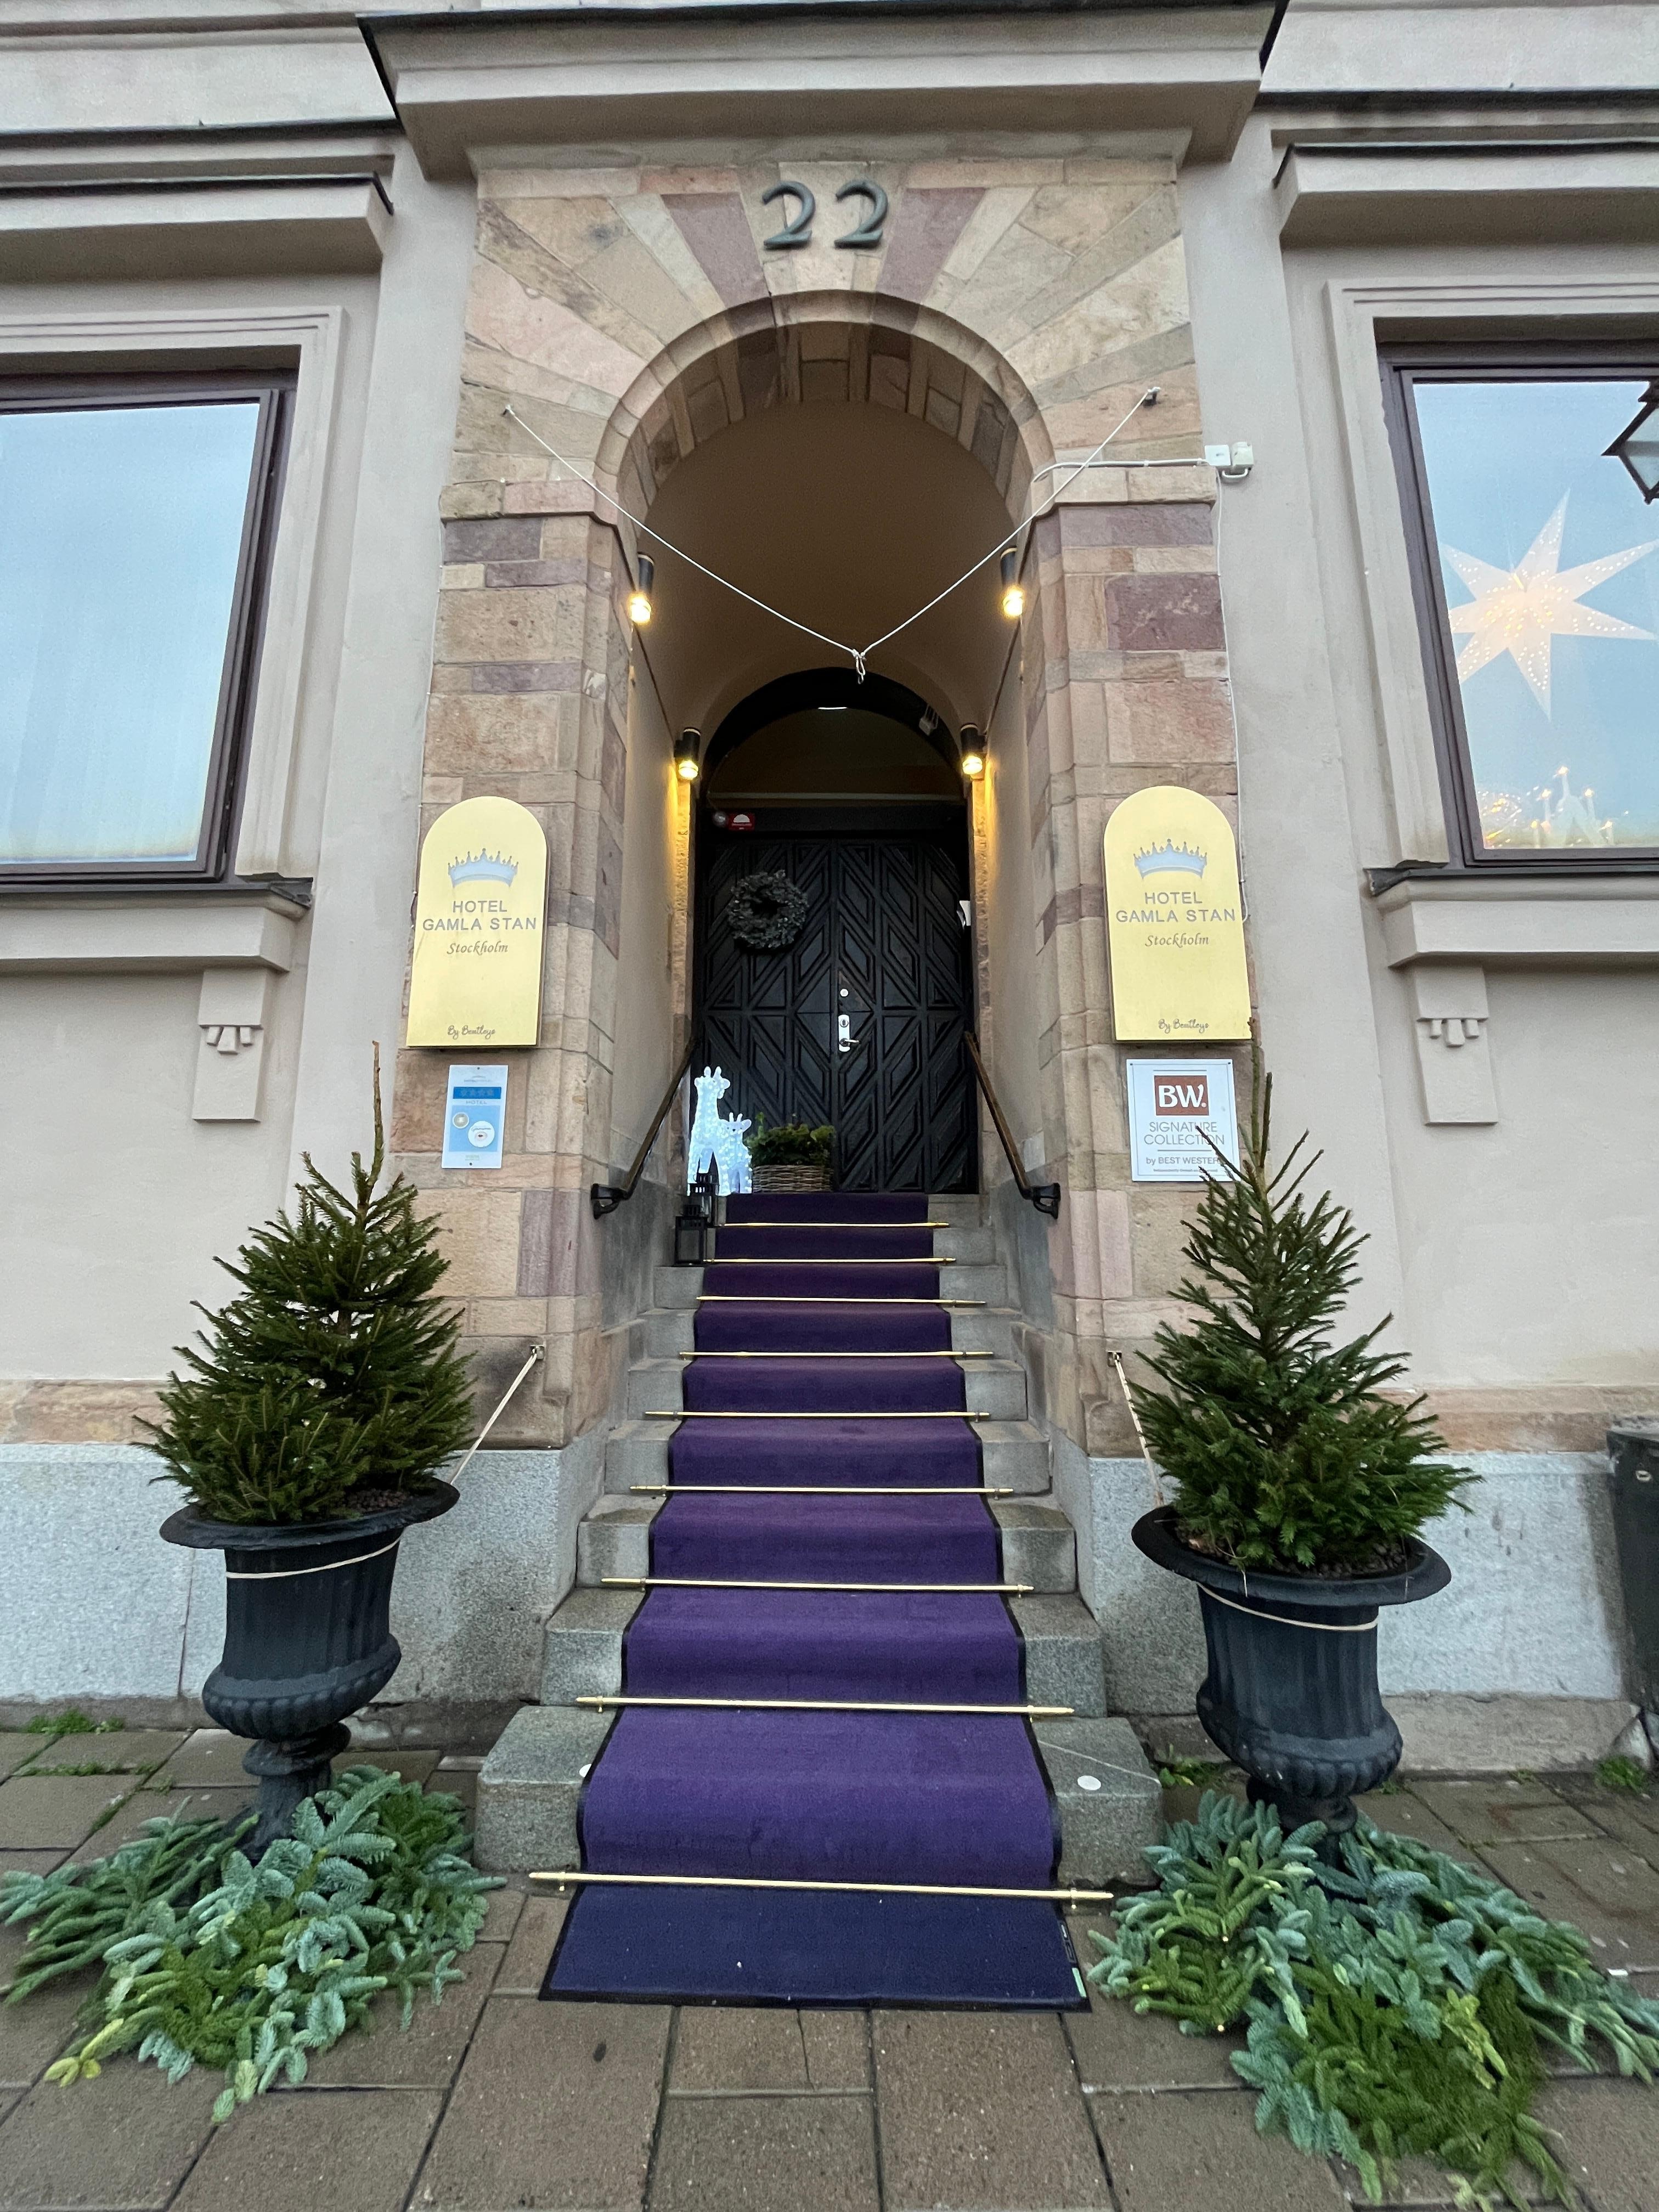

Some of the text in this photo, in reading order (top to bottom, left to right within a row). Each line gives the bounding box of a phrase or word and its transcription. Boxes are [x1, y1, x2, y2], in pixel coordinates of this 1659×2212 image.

[762, 180, 888, 250] 22
[1144, 891, 1203, 904] HOTEL
[453, 900, 507, 913] HOTEL
[1116, 909, 1235, 923] GAMLA STAN
[422, 917, 537, 931] GAMLA STAN
[1144, 933, 1209, 948] Stockholm
[447, 940, 508, 956] Stockholm
[448, 1025, 495, 1040] By Bentleys
[1158, 1018, 1209, 1034] By Bentleys
[1144, 1134, 1225, 1145] COLLECTION
[1146, 1156, 1156, 1166] by
